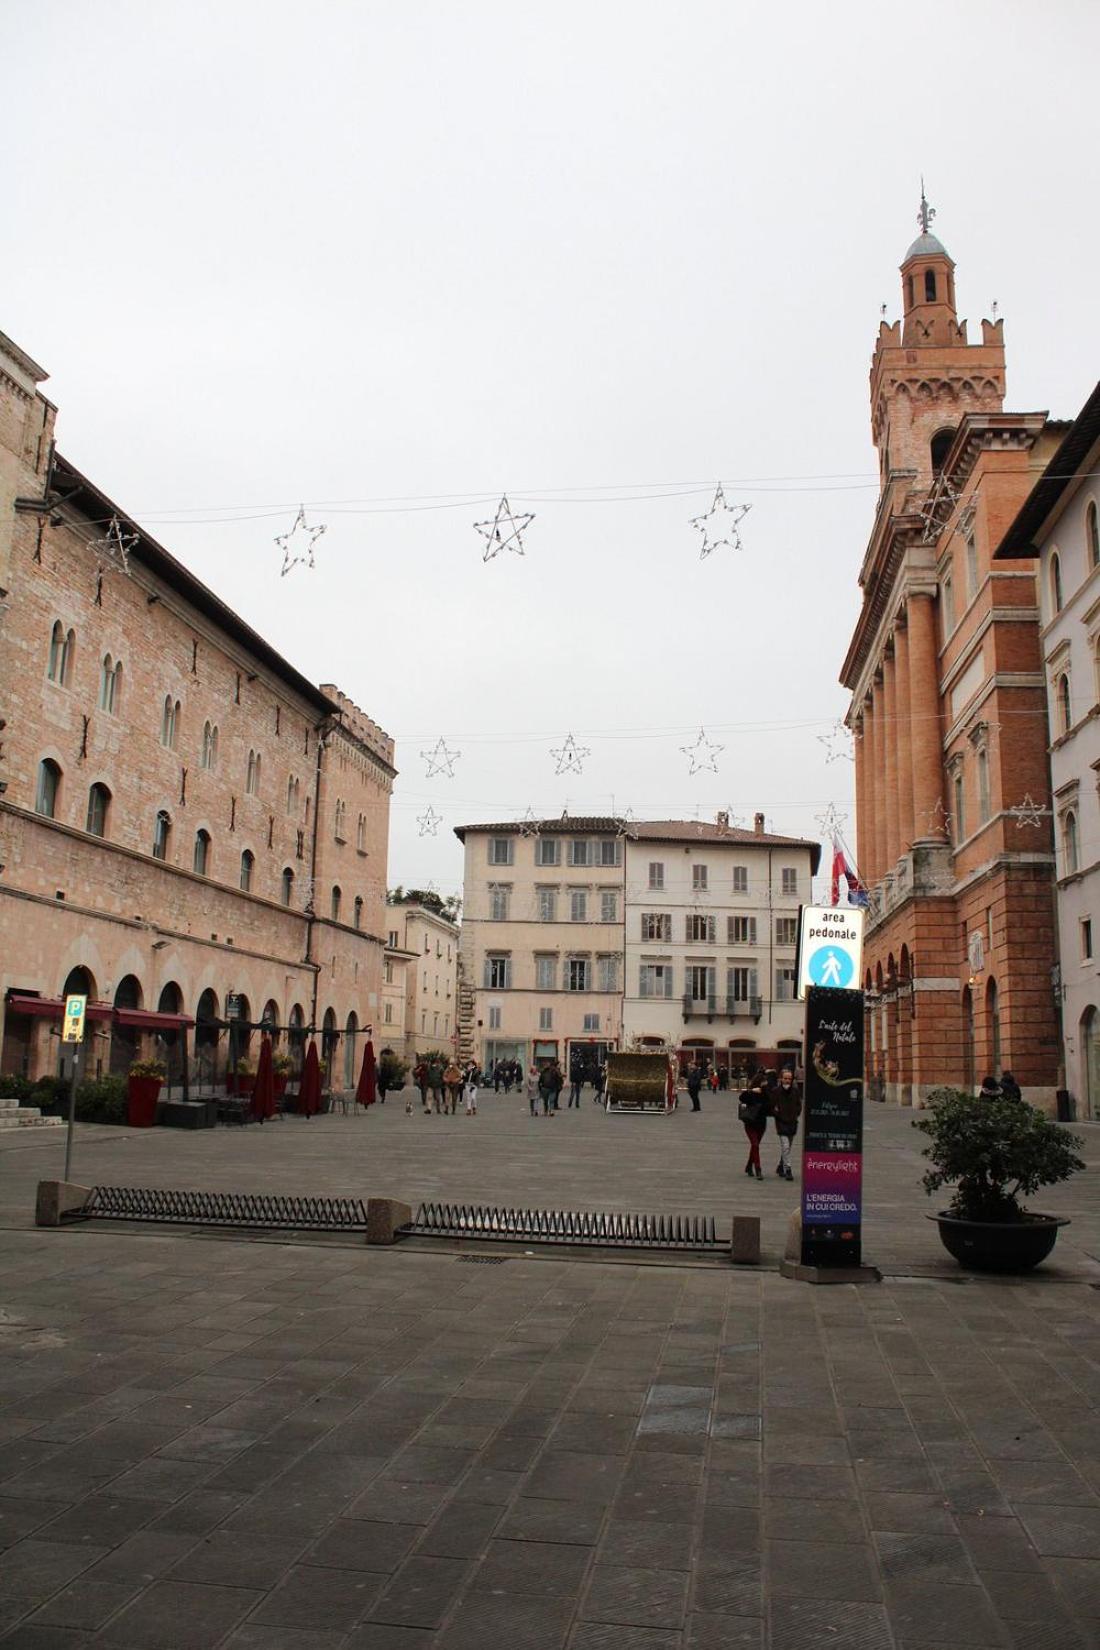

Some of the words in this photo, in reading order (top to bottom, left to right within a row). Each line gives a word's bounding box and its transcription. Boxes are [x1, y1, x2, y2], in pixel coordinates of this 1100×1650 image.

[823, 913, 845, 923] area
[809, 927, 857, 940] pedonale
[806, 1193, 846, 1202] L'ENERGIA
[806, 1202, 814, 1211] IN
